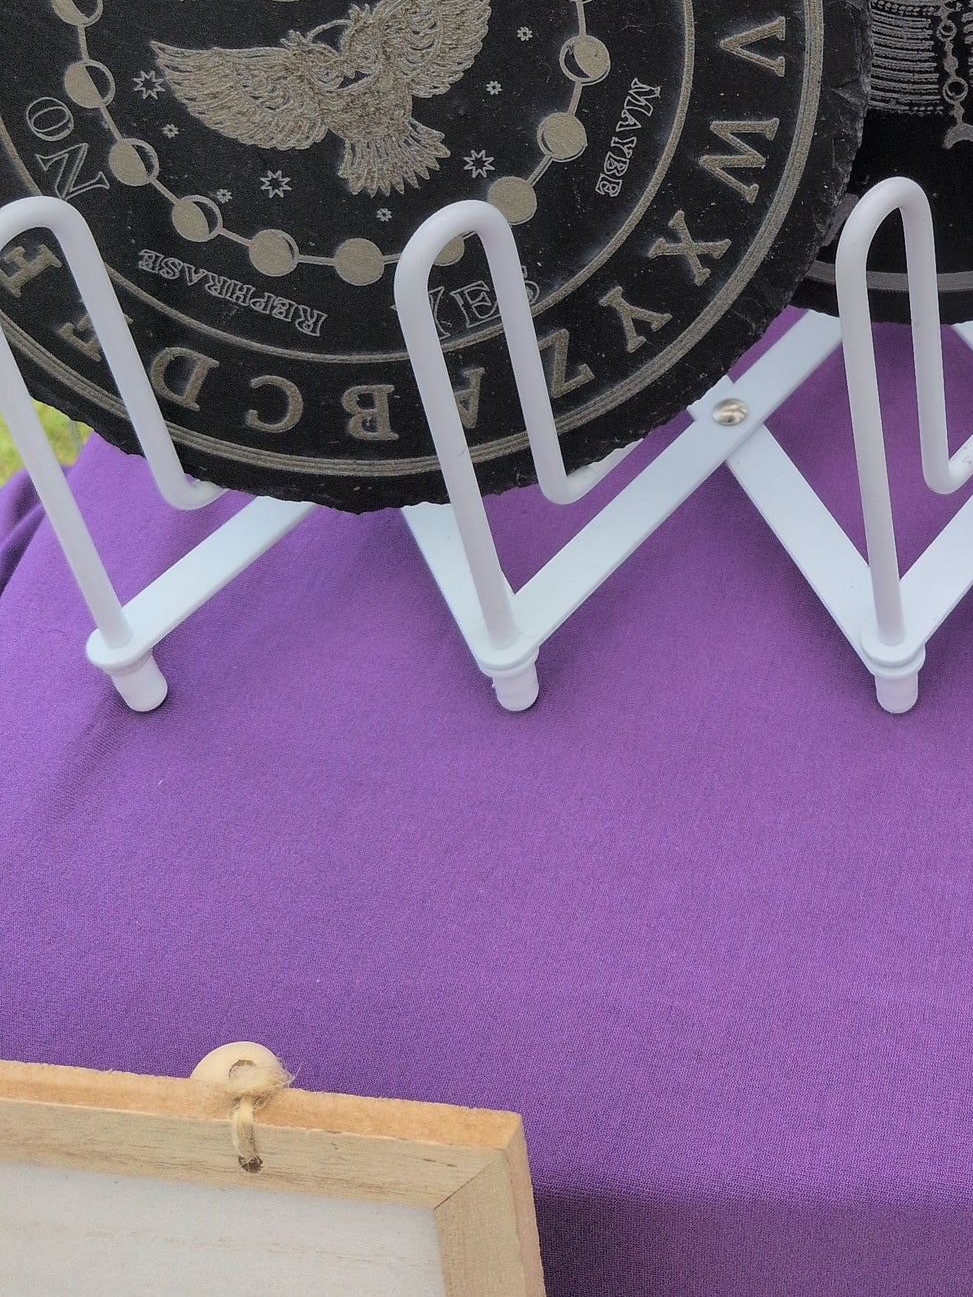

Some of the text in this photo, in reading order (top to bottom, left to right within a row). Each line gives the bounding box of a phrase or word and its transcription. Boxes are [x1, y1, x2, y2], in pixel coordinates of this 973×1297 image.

[26, 97, 110, 200] NO
[595, 78, 661, 197] MAYBE
[139, 249, 328, 336] REPHRASE
